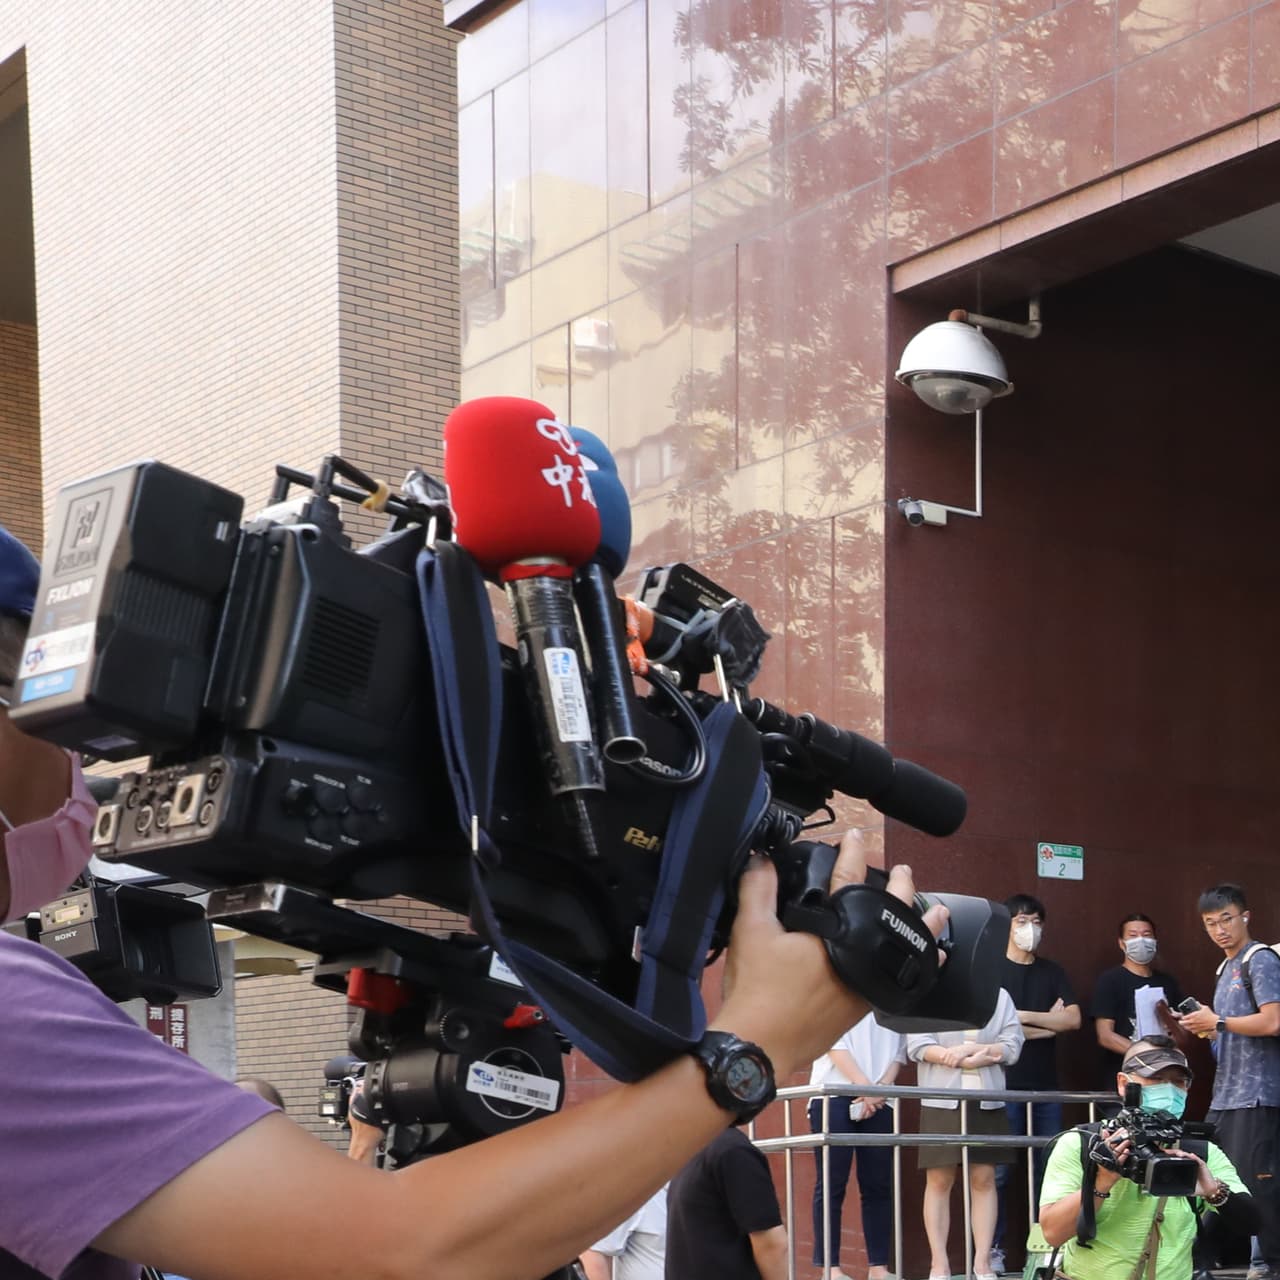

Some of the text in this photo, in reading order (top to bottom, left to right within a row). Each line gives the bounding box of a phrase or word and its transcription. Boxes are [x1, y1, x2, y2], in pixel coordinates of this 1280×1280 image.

[624, 827, 660, 852] P2H
[1058, 862, 1066, 876] 2
[54, 930, 78, 942] SONY
[881, 908, 928, 953] FUJINON
